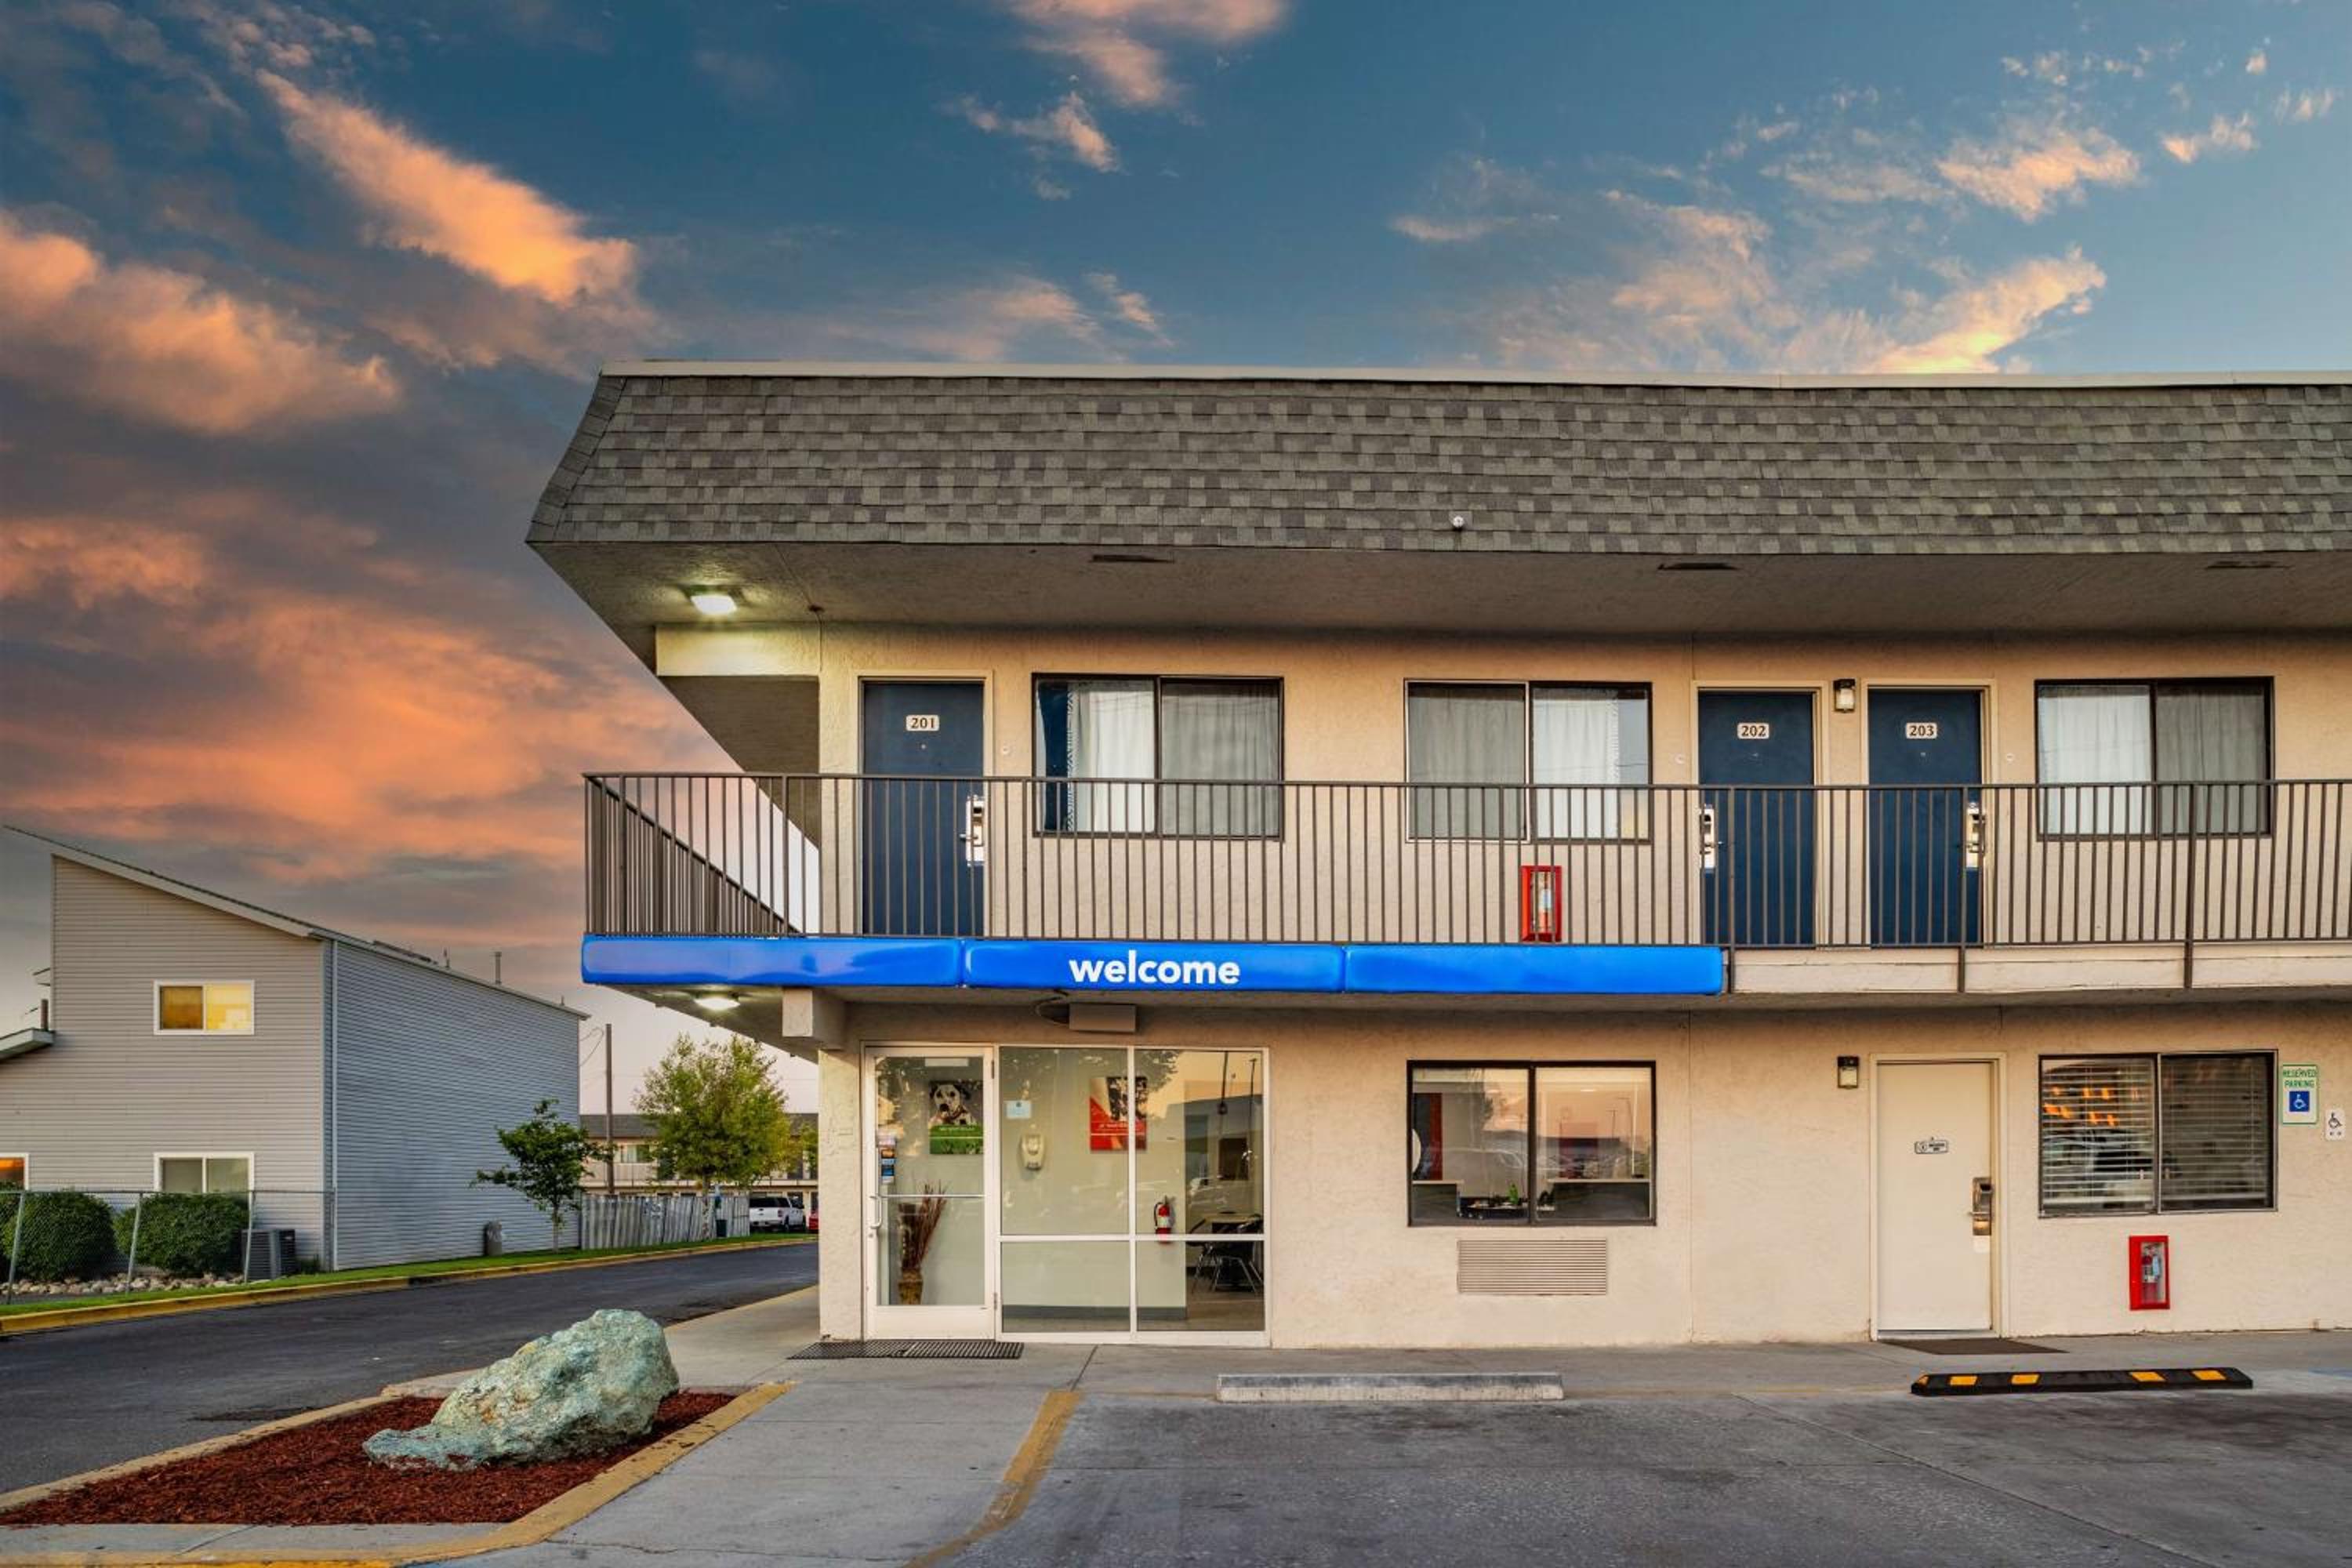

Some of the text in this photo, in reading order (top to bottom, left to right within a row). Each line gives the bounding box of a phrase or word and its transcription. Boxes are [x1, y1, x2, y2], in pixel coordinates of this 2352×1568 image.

[911, 717, 935, 728] 201
[1741, 725, 1766, 737] 202
[1909, 725, 1934, 736] 203
[1069, 949, 1240, 984] welcome
[2282, 1069, 2317, 1078] RESERVED
[2285, 1080, 2314, 1088] PARKING
